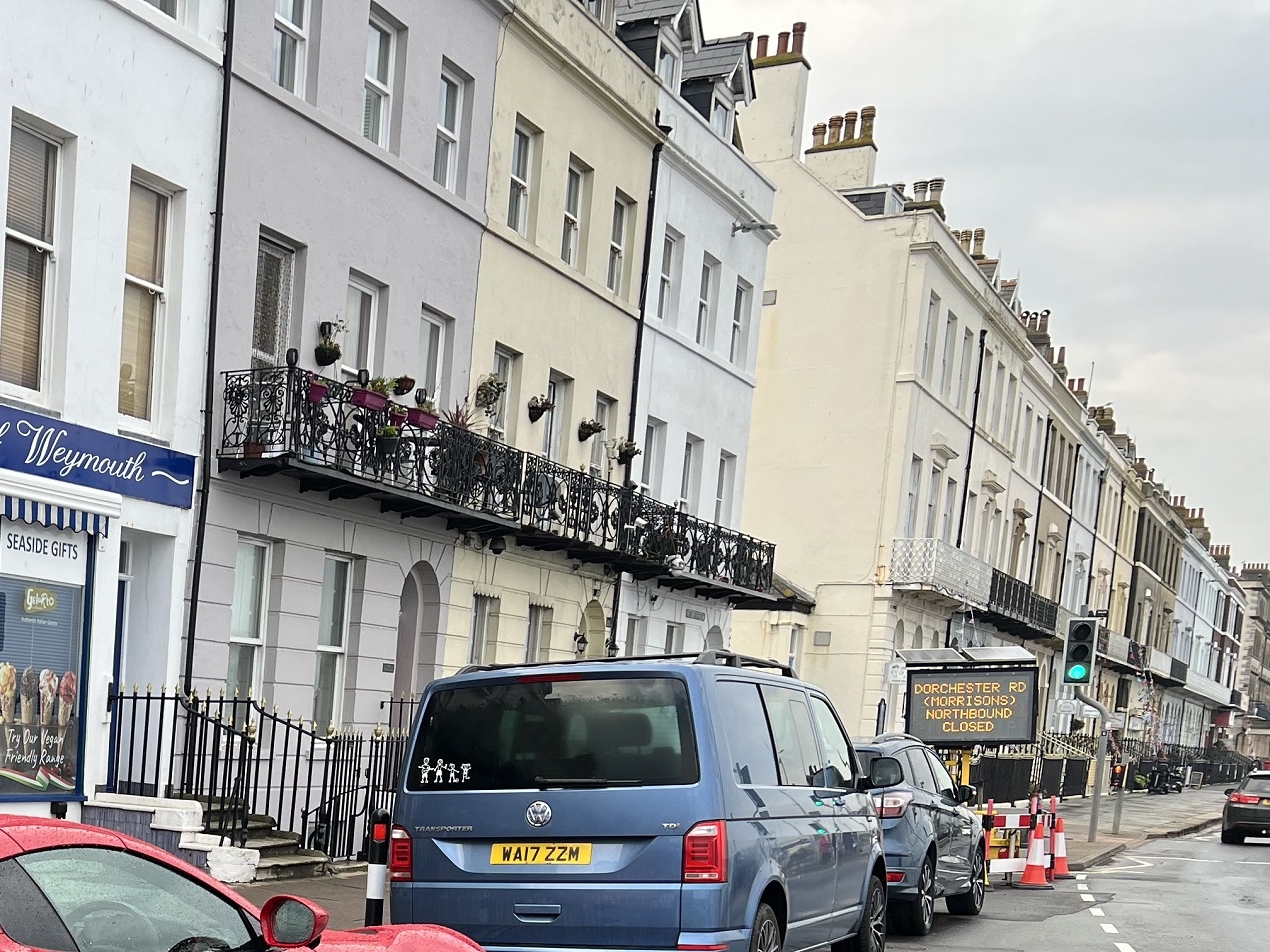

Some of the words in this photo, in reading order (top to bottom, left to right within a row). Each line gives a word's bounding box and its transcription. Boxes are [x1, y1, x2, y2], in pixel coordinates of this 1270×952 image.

[16, 420, 145, 483] Weymouth
[7, 533, 49, 556] SEASIDE
[52, 540, 79, 560] GIFTS
[914, 682, 1001, 695] DORCHESTER
[1008, 681, 1027, 693] RD
[923, 695, 1016, 707] (MORRISONS)
[926, 708, 1013, 720] NORTHBOUND
[942, 721, 994, 732] CLOSED
[8, 728, 21, 748] Try
[24, 728, 38, 745] Our
[41, 729, 64, 748] Vegan
[5, 748, 38, 768] Friendly
[39, 749, 65, 767] Range
[502, 846, 540, 862] WA17
[545, 846, 579, 862] ZZM
